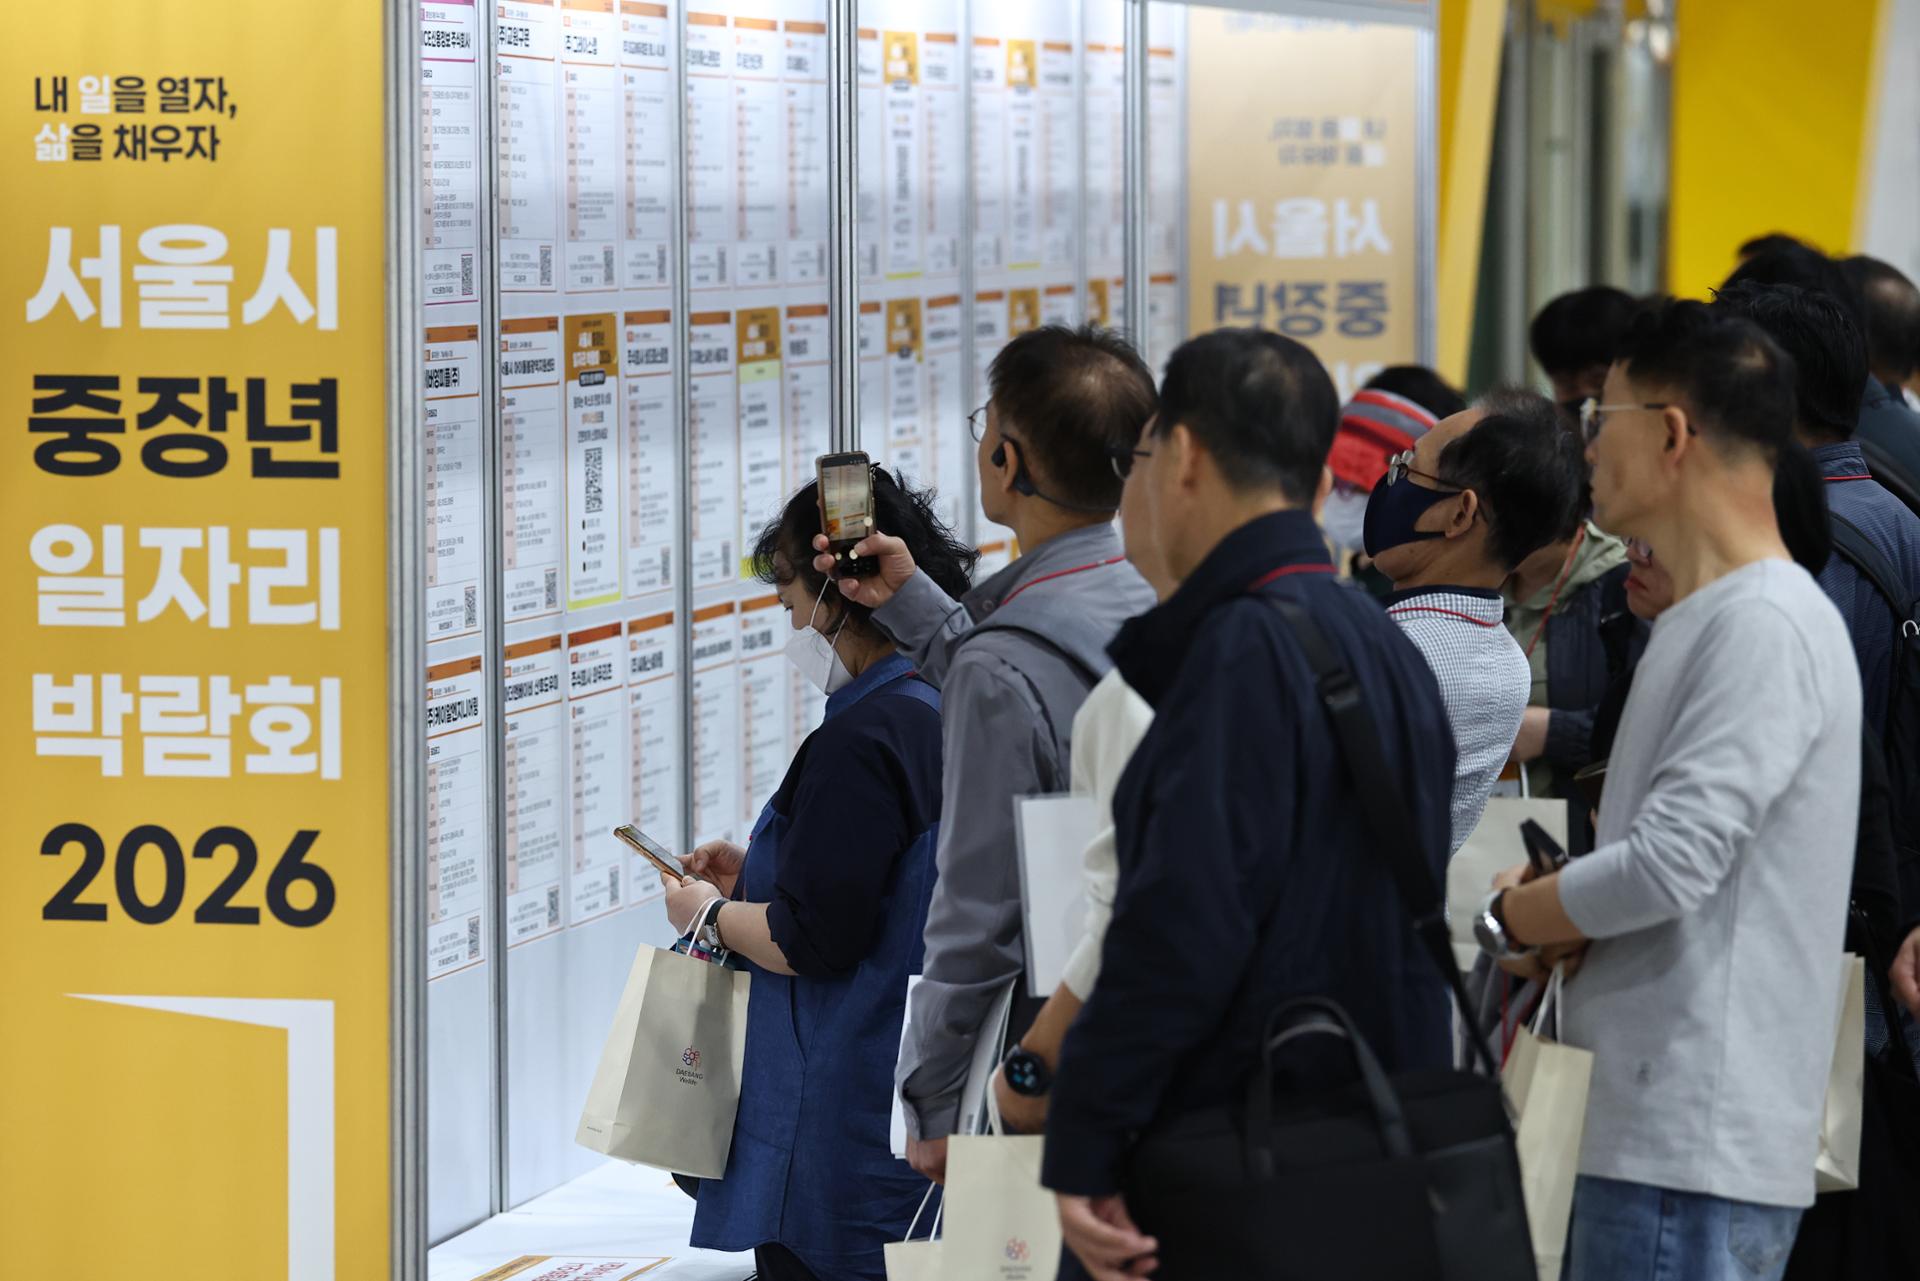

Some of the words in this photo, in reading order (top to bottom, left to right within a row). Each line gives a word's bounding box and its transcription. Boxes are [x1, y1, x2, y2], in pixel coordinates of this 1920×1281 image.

[34, 76, 68, 113] 내
[79, 75, 146, 114] 일을
[157, 76, 237, 118] 열자,
[34, 123, 102, 162] 삶을
[113, 124, 219, 162] 채우자
[26, 224, 338, 330] 서울시
[28, 374, 340, 480] 중장년
[29, 523, 341, 630] 일자리
[32, 673, 342, 780] 박람회
[40, 822, 336, 928] 2026
